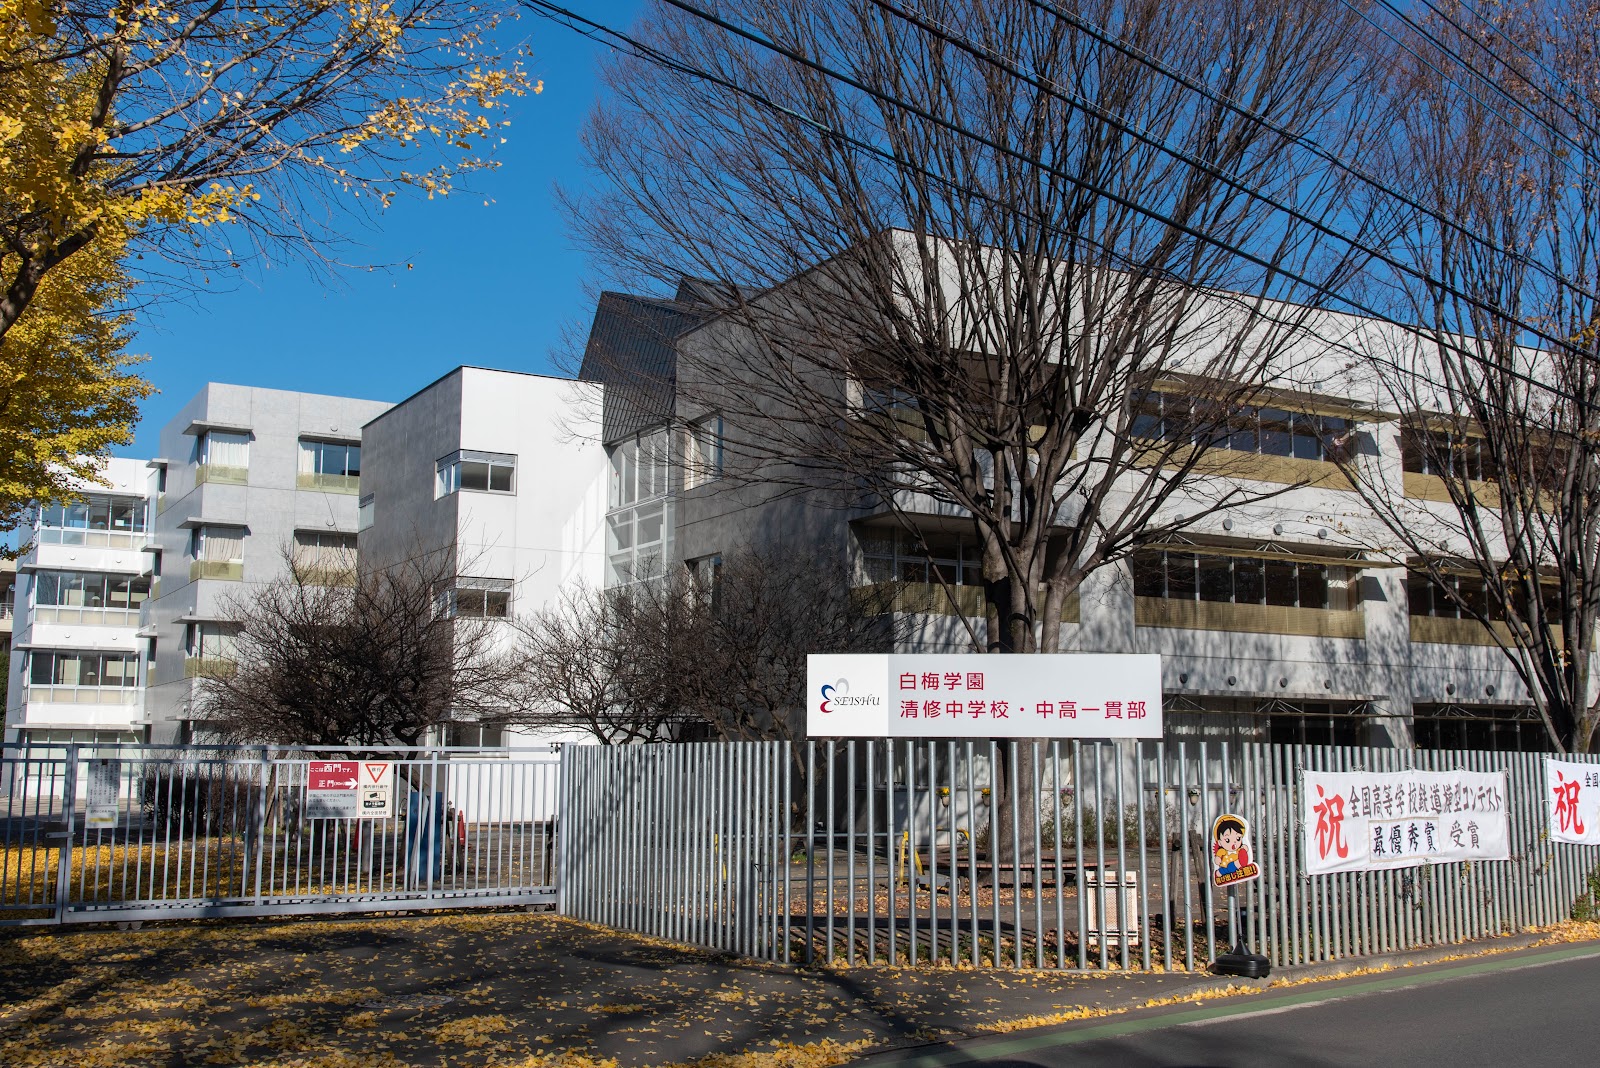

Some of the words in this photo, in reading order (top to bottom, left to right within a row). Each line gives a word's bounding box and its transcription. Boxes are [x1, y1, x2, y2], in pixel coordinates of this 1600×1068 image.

[899, 672, 985, 691] 白梅学園
[833, 693, 881, 706] SEISHU
[900, 700, 1147, 720] 清修中学校・中高一貫部
[1584, 771, 1600, 788] 全国
[1348, 781, 1502, 818] 全国高等学校鉄道模型コンテスト
[1553, 769, 1585, 834] 祝
[1313, 784, 1349, 860] 祝
[1373, 821, 1437, 856] 最優秀賞
[1450, 820, 1480, 849] 受賞
